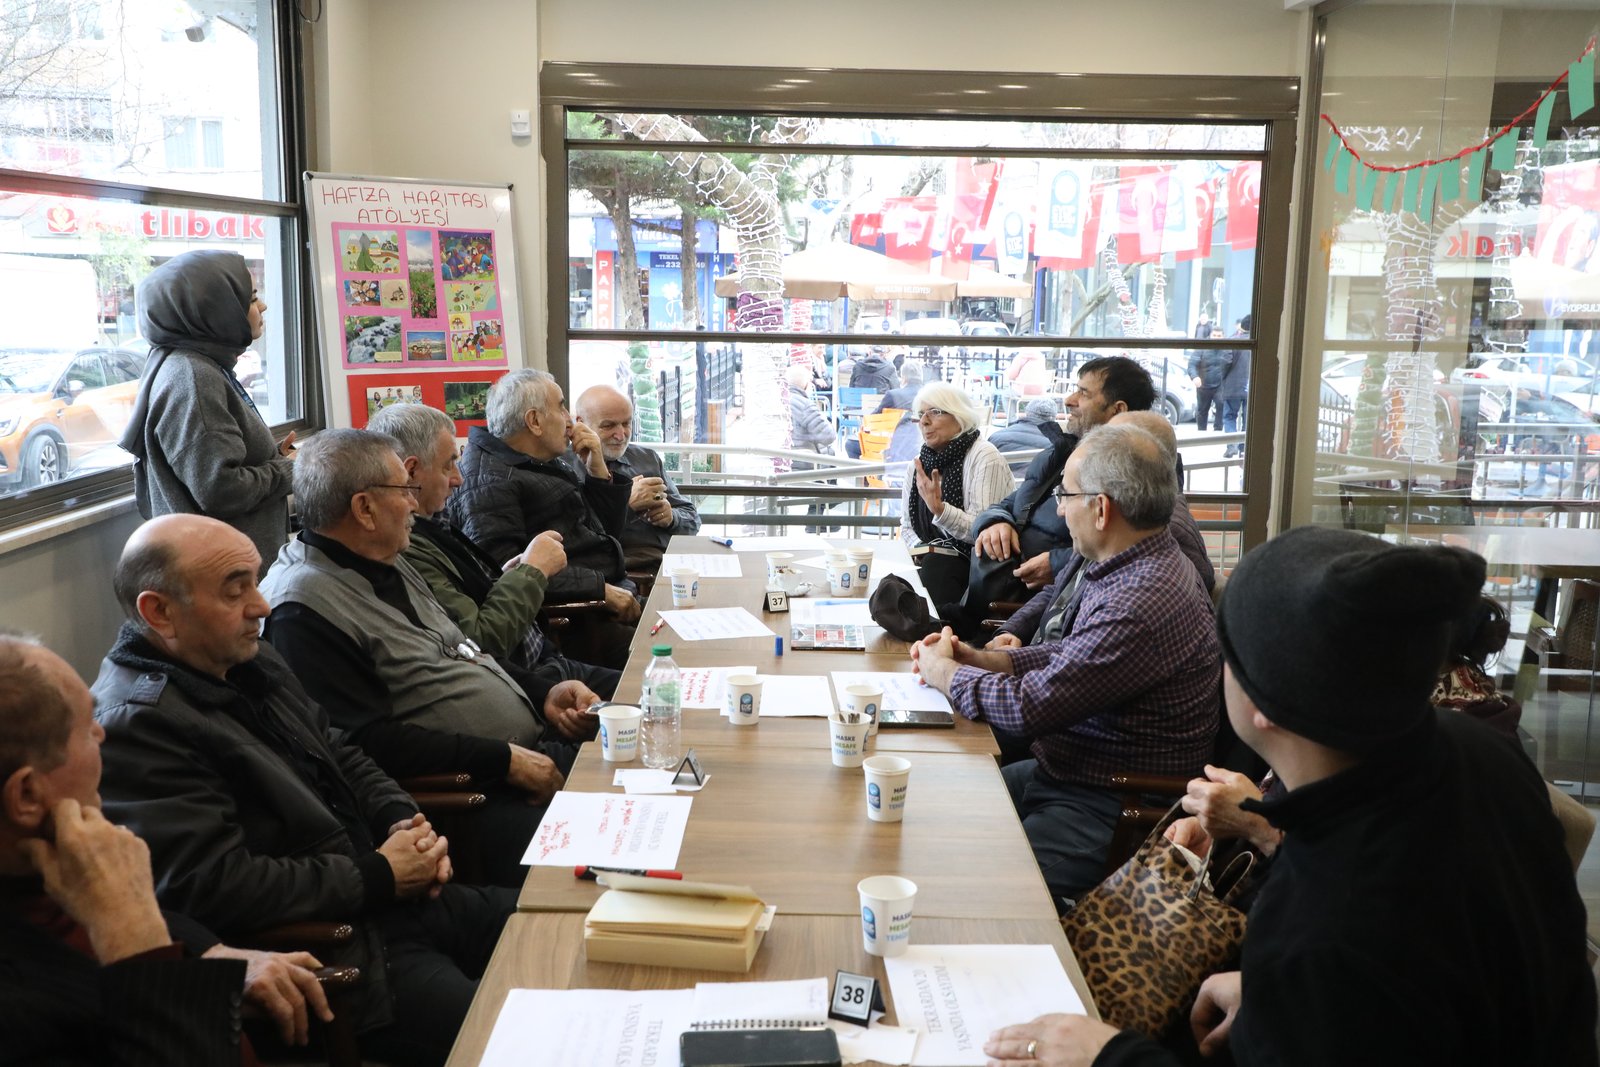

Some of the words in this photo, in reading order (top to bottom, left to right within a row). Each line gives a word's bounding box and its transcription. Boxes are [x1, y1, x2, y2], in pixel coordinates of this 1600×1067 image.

[322, 184, 391, 205] HAFIZA
[358, 206, 450, 227] ATÖLYESİ
[772, 597, 784, 606] 37
[835, 734, 856, 742] MASKE
[841, 985, 865, 1004] 38
